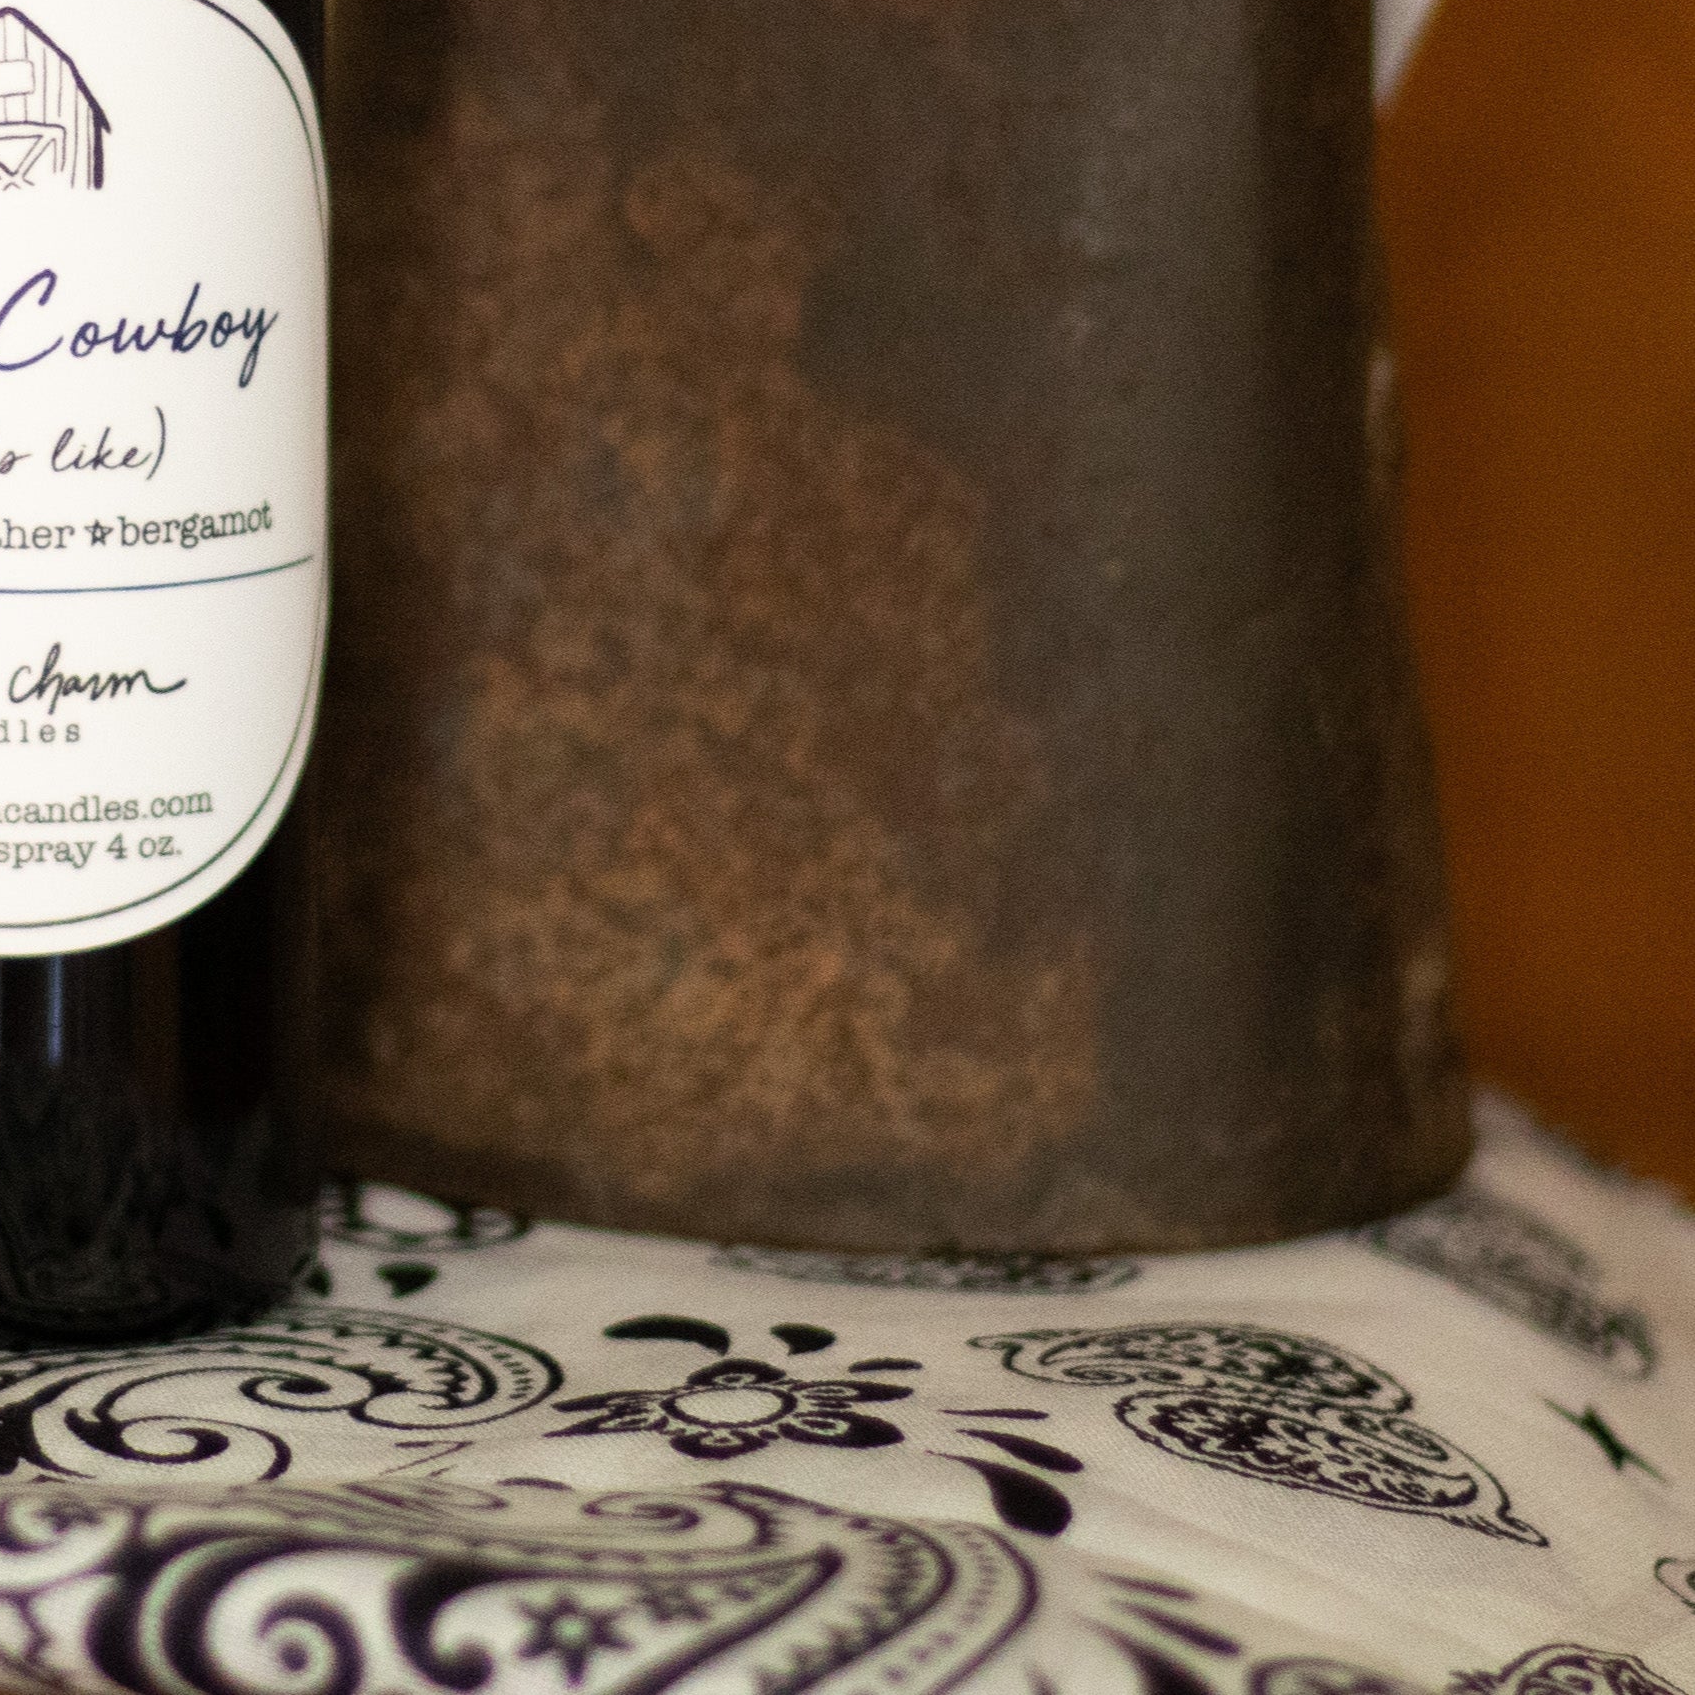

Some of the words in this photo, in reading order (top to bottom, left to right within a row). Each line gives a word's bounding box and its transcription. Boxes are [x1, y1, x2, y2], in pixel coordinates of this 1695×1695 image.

[50, 405, 168, 481] like)
[116, 500, 273, 551] bergamot
[7, 641, 189, 717] charm
[105, 833, 128, 861] 4
[138, 834, 184, 860] oz.
